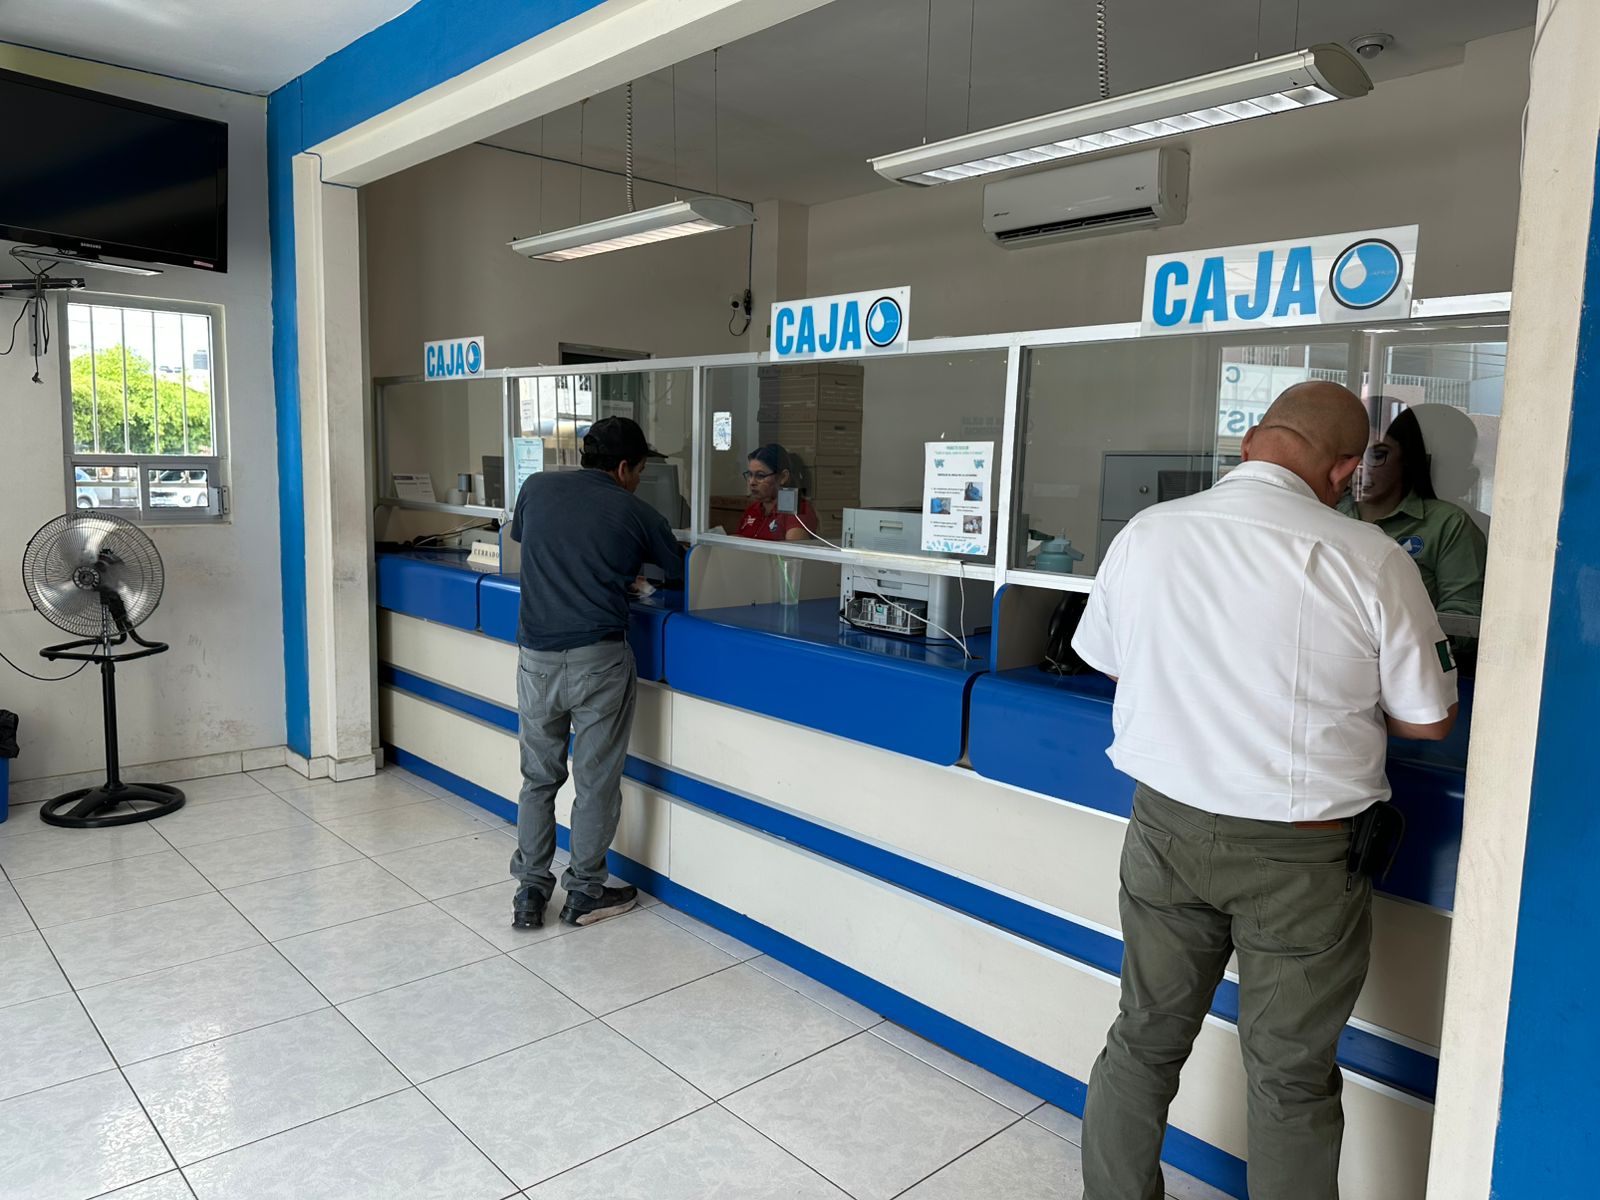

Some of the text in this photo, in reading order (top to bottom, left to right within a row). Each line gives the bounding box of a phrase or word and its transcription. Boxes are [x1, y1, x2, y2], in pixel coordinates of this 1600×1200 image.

[1152, 246, 1318, 328] CAJA
[775, 300, 863, 358] CAJA
[427, 342, 466, 378] CAJA
